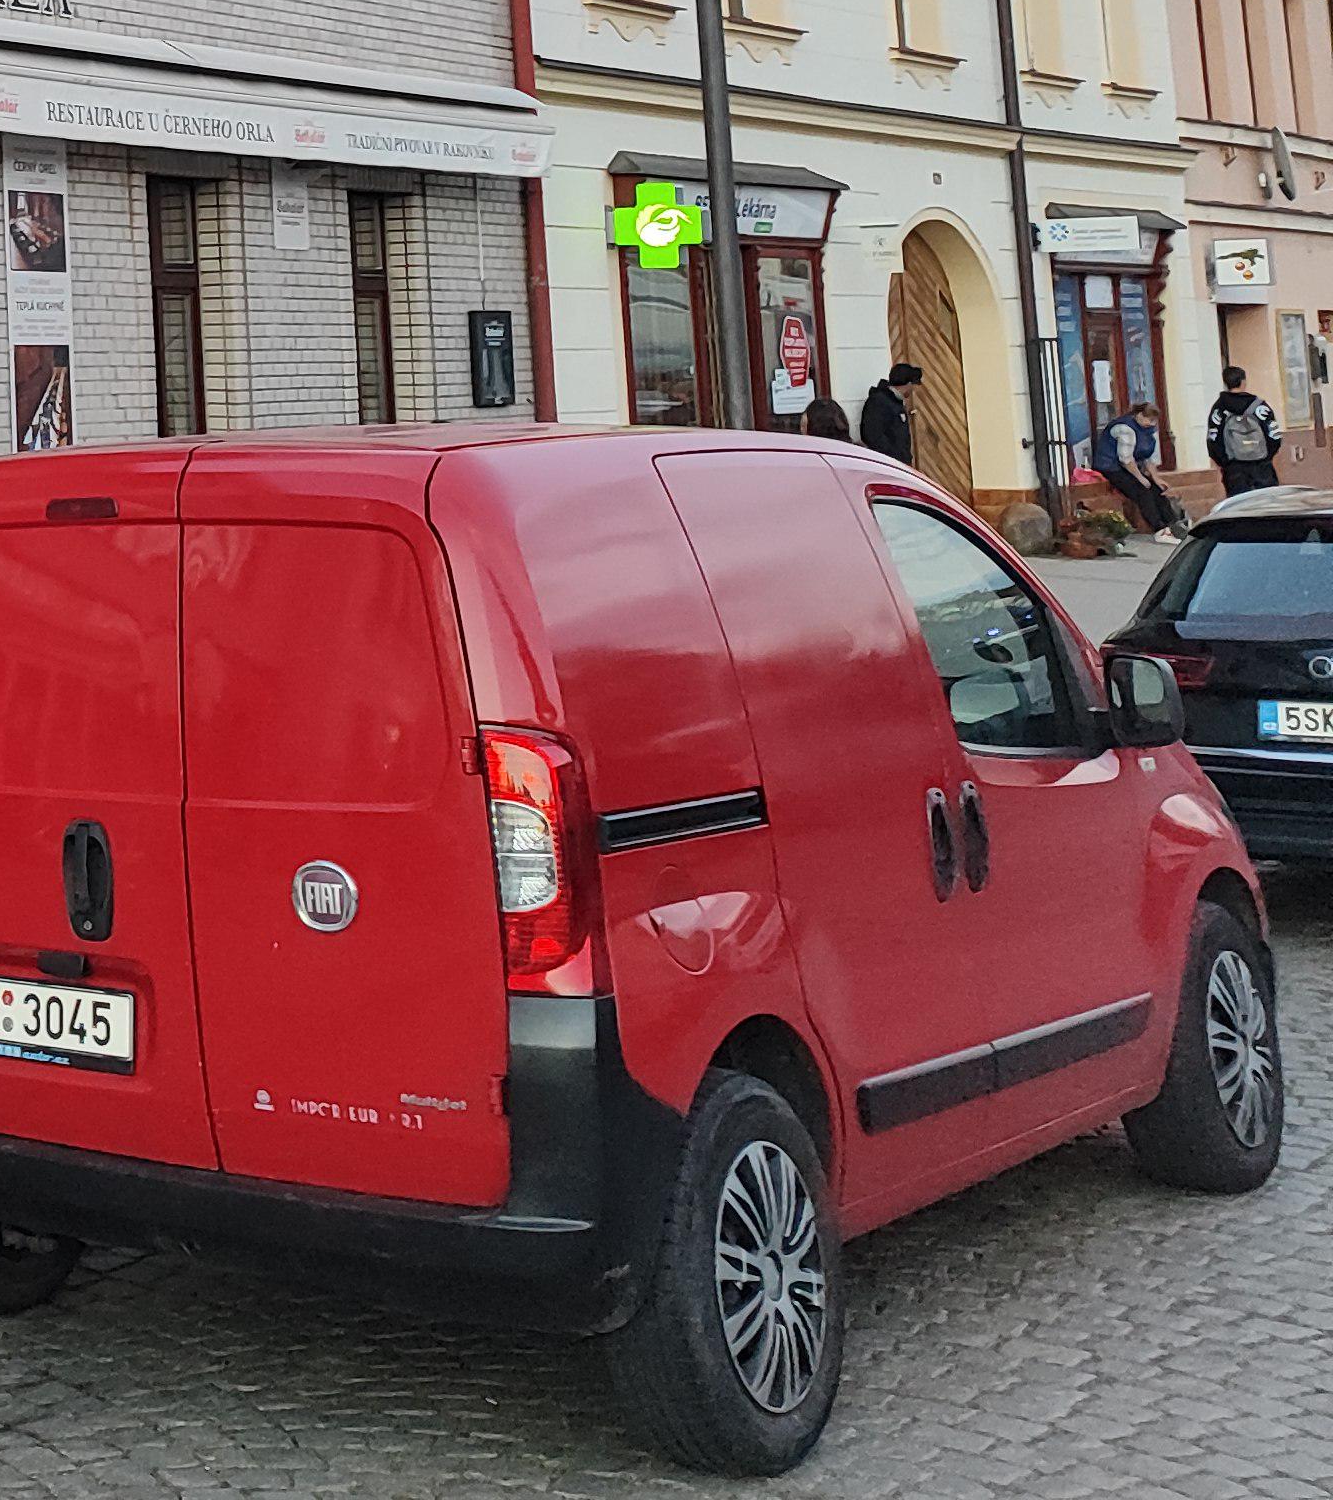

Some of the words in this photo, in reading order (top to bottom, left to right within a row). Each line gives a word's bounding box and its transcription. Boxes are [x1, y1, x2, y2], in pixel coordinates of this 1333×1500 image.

[46, 101, 145, 131] RESTAURACE
[147, 112, 160, 132] U
[235, 121, 276, 143] ORLA
[1285, 706, 1333, 733] 5SK
[305, 881, 343, 914] FIAT
[22, 993, 112, 1046] 3045
